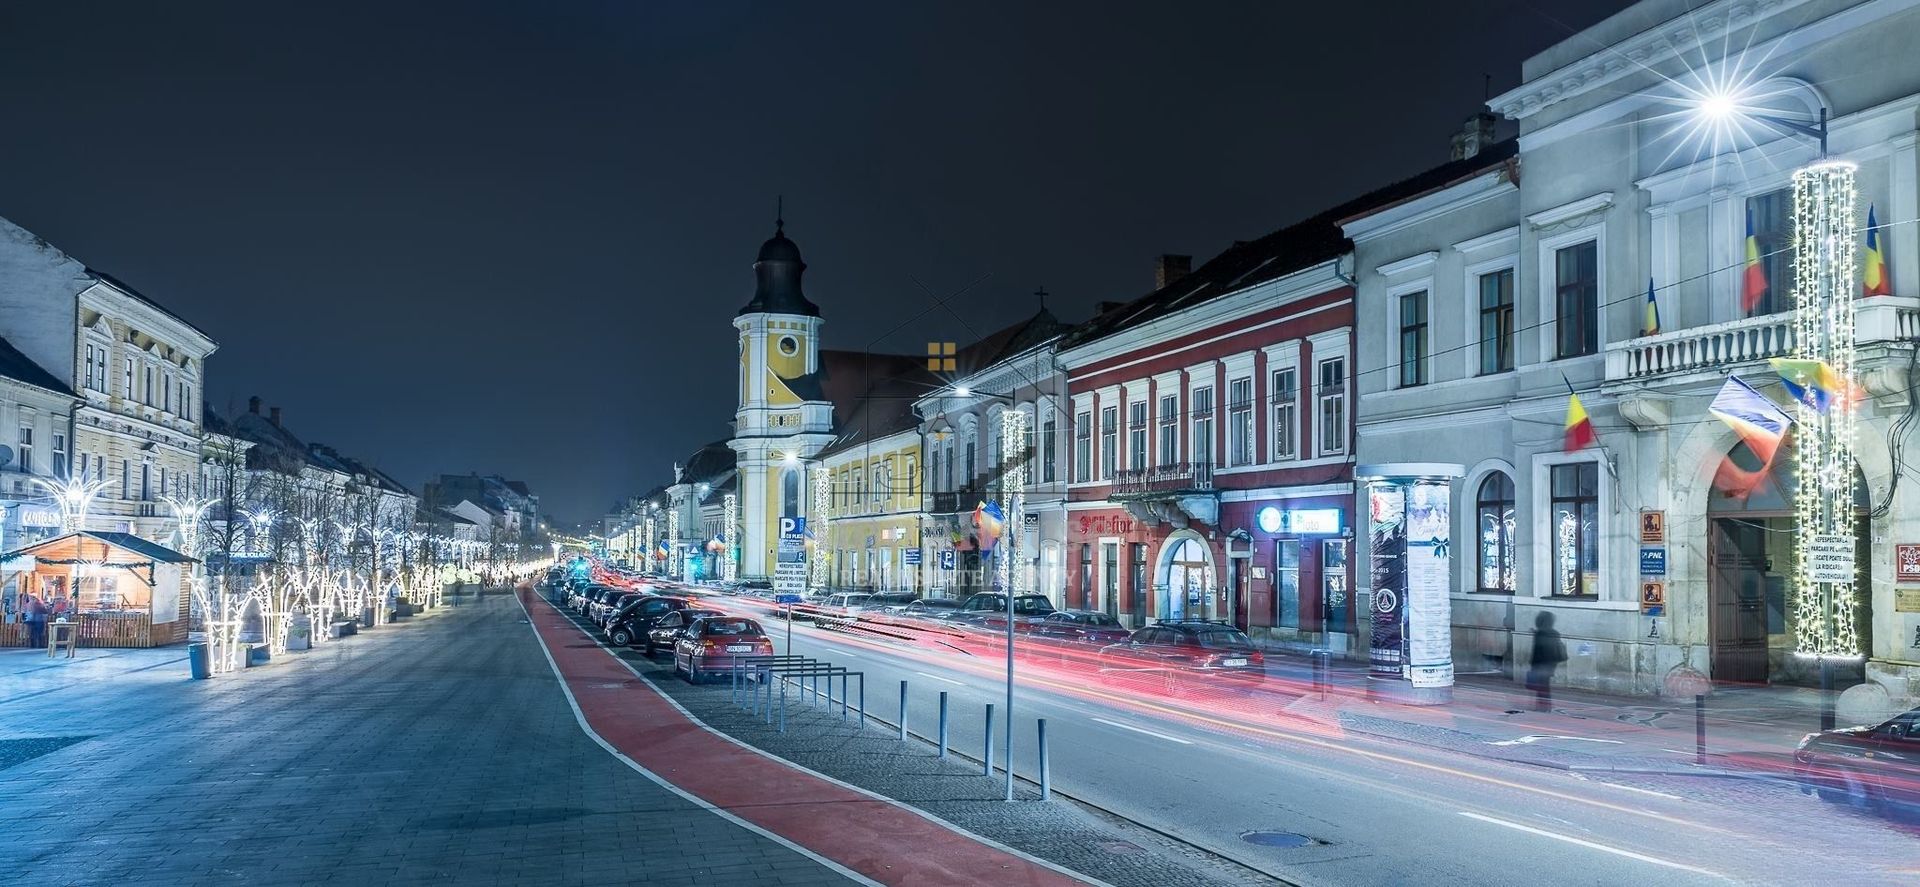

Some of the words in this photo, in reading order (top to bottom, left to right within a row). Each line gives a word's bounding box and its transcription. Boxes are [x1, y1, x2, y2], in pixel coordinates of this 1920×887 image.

[781, 518, 795, 539] P
[945, 551, 953, 562] P
[1648, 551, 1663, 559] PNL
